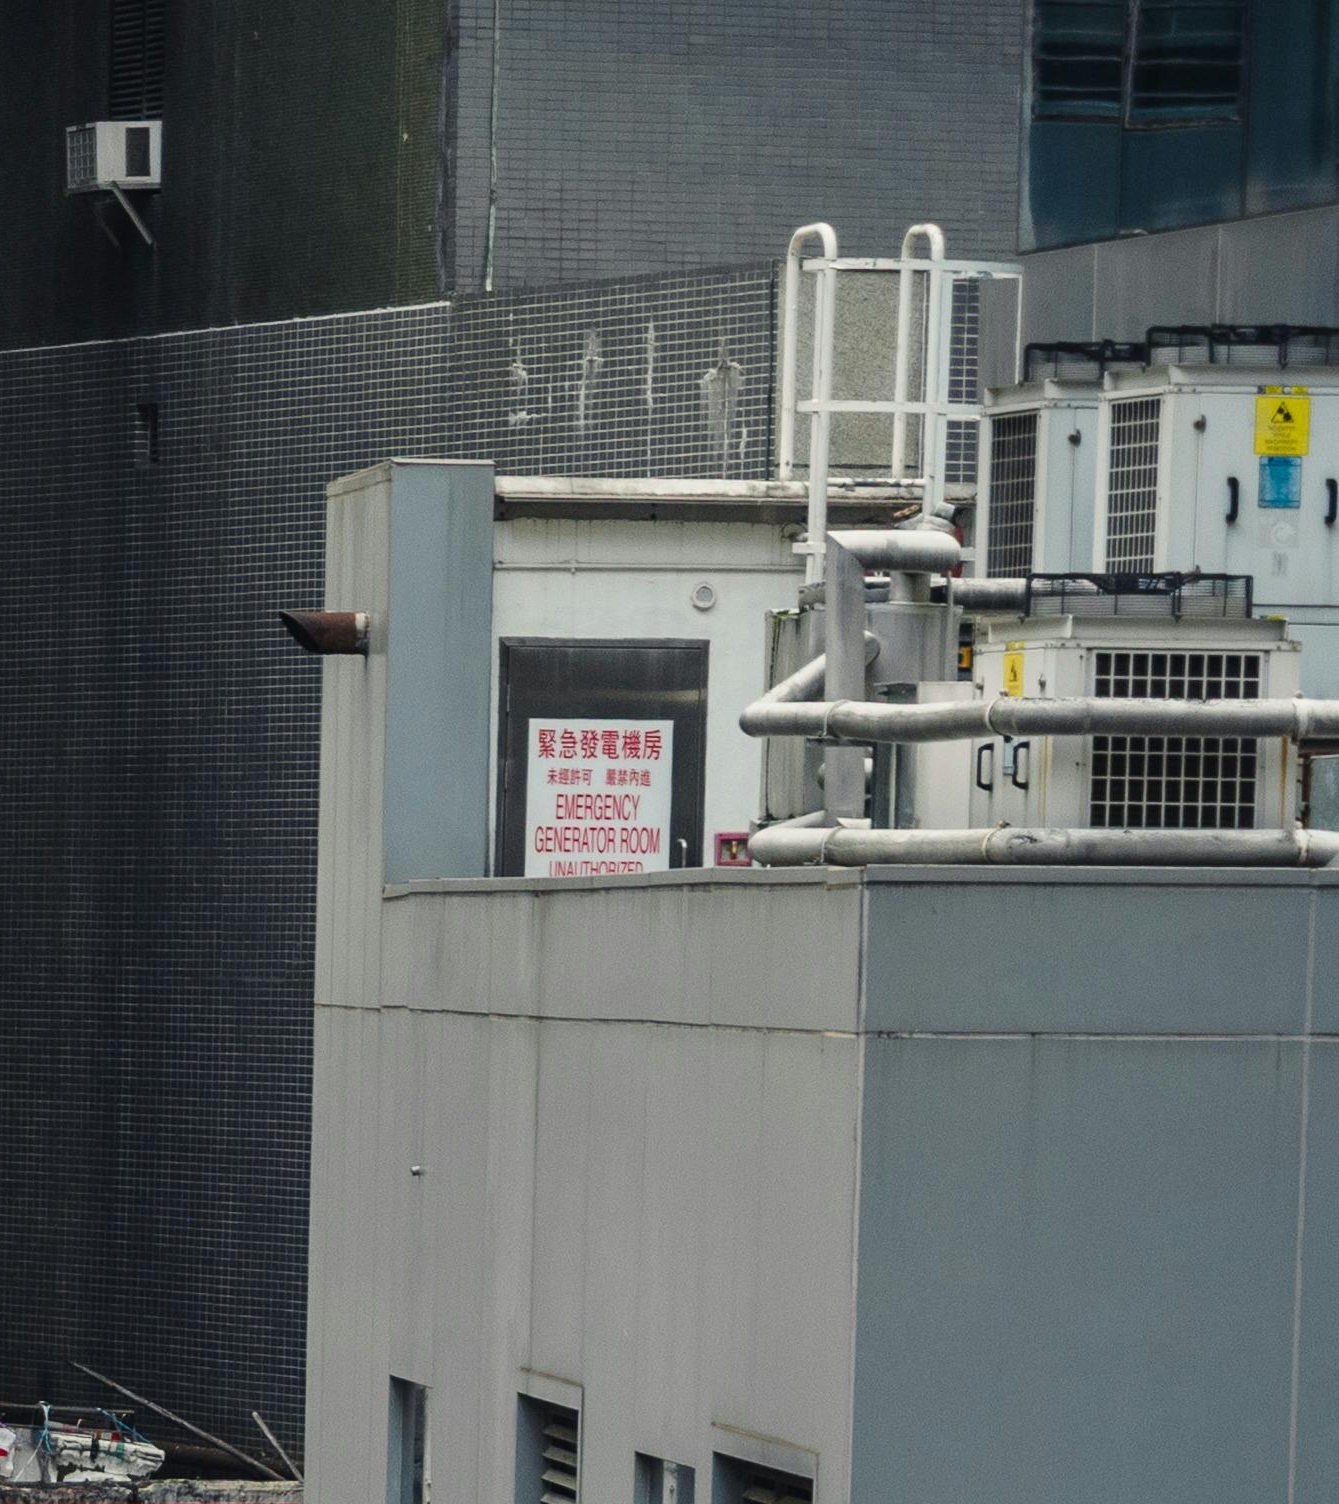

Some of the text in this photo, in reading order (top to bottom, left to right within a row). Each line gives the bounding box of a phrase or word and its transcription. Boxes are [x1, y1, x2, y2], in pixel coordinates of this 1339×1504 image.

[537, 728, 663, 760] 緊急發電機房
[555, 794, 641, 820] EMERGENCY
[534, 826, 661, 854] GENERATOR ROOM
